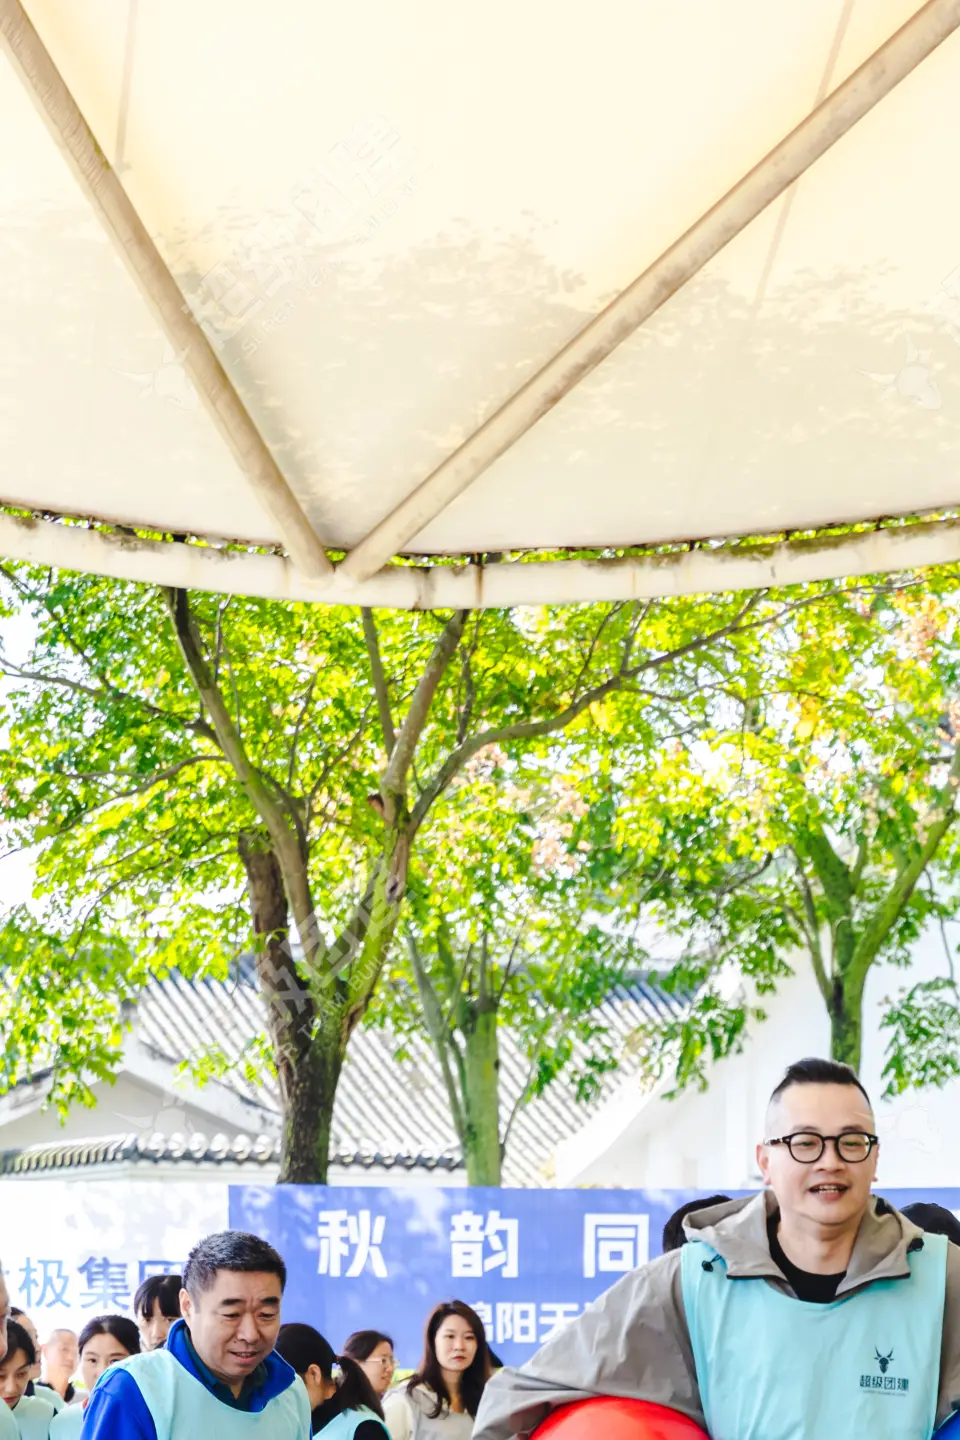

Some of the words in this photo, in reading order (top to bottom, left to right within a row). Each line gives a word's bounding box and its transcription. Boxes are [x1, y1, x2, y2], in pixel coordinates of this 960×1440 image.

[317, 1208, 650, 1278] 秋韵同
[3, 1256, 186, 1310] 极集
[860, 1374, 909, 1391] 超级团建
